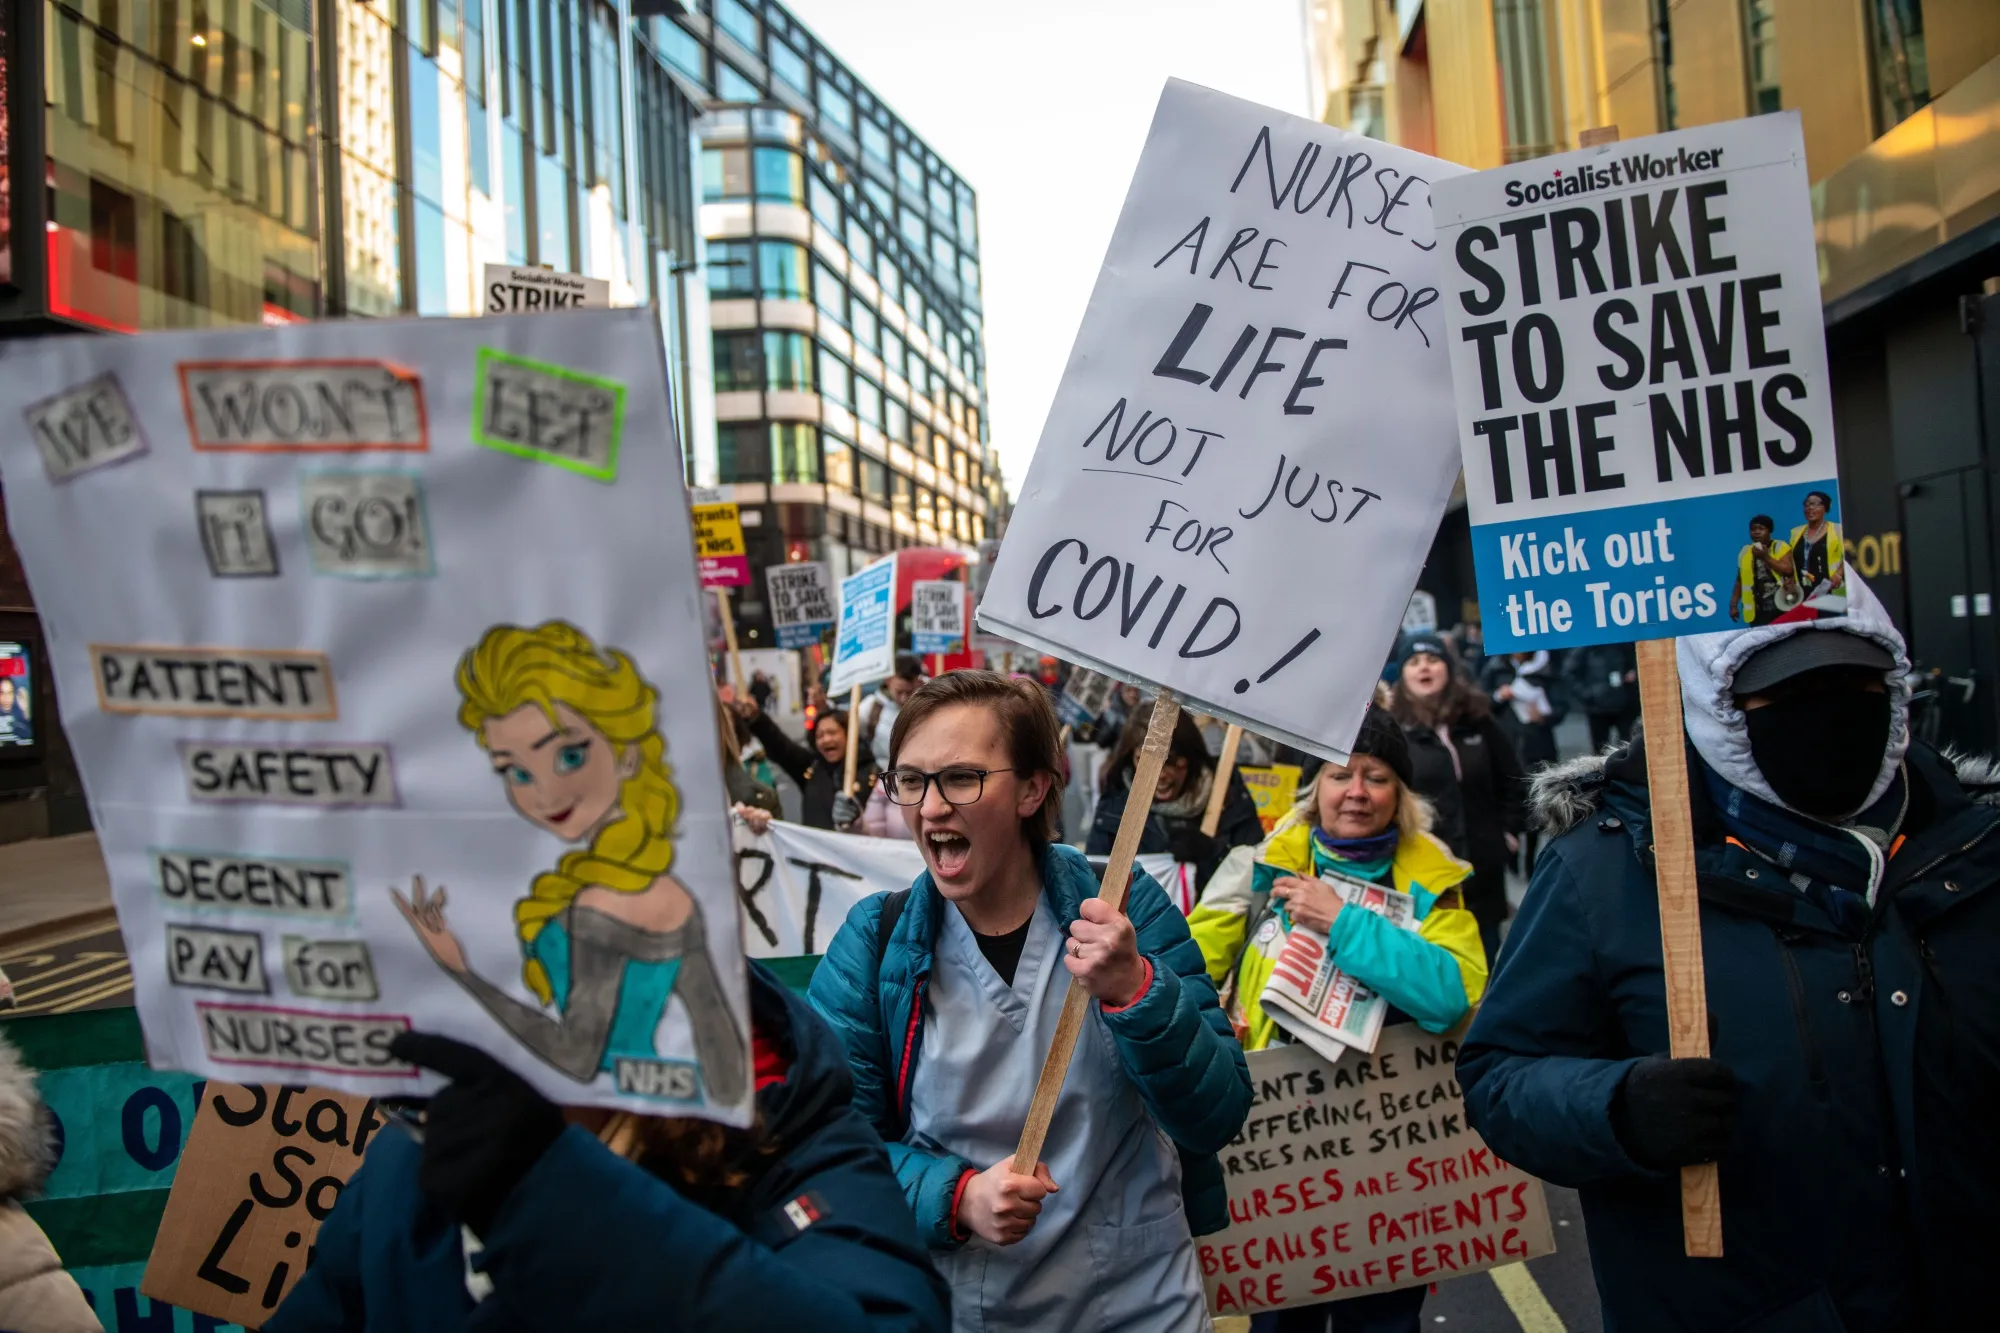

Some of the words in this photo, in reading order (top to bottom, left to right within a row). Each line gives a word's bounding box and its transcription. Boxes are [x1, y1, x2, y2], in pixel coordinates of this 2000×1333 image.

[1455, 180, 1737, 316] STRIKE
[489, 282, 586, 314] STRIKE
[1154, 217, 1288, 291] ARE
[1328, 261, 1440, 349] FOR
[1152, 302, 1349, 415] LIFE
[1462, 313, 1565, 411] TO
[1593, 273, 1791, 392] SAVE
[37, 388, 131, 467] WE
[485, 377, 613, 460] LET
[1473, 400, 1626, 505] THE
[1649, 373, 1813, 484] NHS
[1082, 397, 1226, 478] NOT
[1239, 454, 1382, 525] JUST
[208, 501, 255, 567] IT
[311, 494, 422, 561] GO!
[1145, 499, 1234, 575] FOR
[1500, 527, 1591, 581] Kick
[1604, 518, 1675, 569] out
[770, 571, 818, 590] STRIKE
[795, 586, 828, 605] SAVE
[805, 602, 833, 619] NHS
[1506, 590, 1574, 638] the
[1585, 576, 1718, 629] Tories
[1027, 538, 1322, 695] COVID!
[101, 655, 319, 708] PATIENT
[191, 750, 382, 796] SAFETY
[158, 858, 343, 909] DECENT
[174, 938, 254, 982] PAY
[291, 944, 365, 990] for
[1272, 932, 1324, 997] OUT
[203, 1014, 395, 1066] NURSES
[1335, 1053, 1400, 1090] ARE
[619, 1061, 693, 1098] NHS
[1220, 1143, 1294, 1177] RSES
[1303, 1137, 1355, 1162] ARE
[1228, 1167, 1344, 1226] URSES
[1353, 1171, 1403, 1199] ARE
[1406, 1146, 1508, 1192] STRIK
[196, 1198, 318, 1310] Li
[1199, 1222, 1353, 1277] BECAUSE
[1368, 1180, 1529, 1248] PATIENTS
[1215, 1272, 1289, 1313] ARE
[1310, 1227, 1528, 1295] SUFFERING
